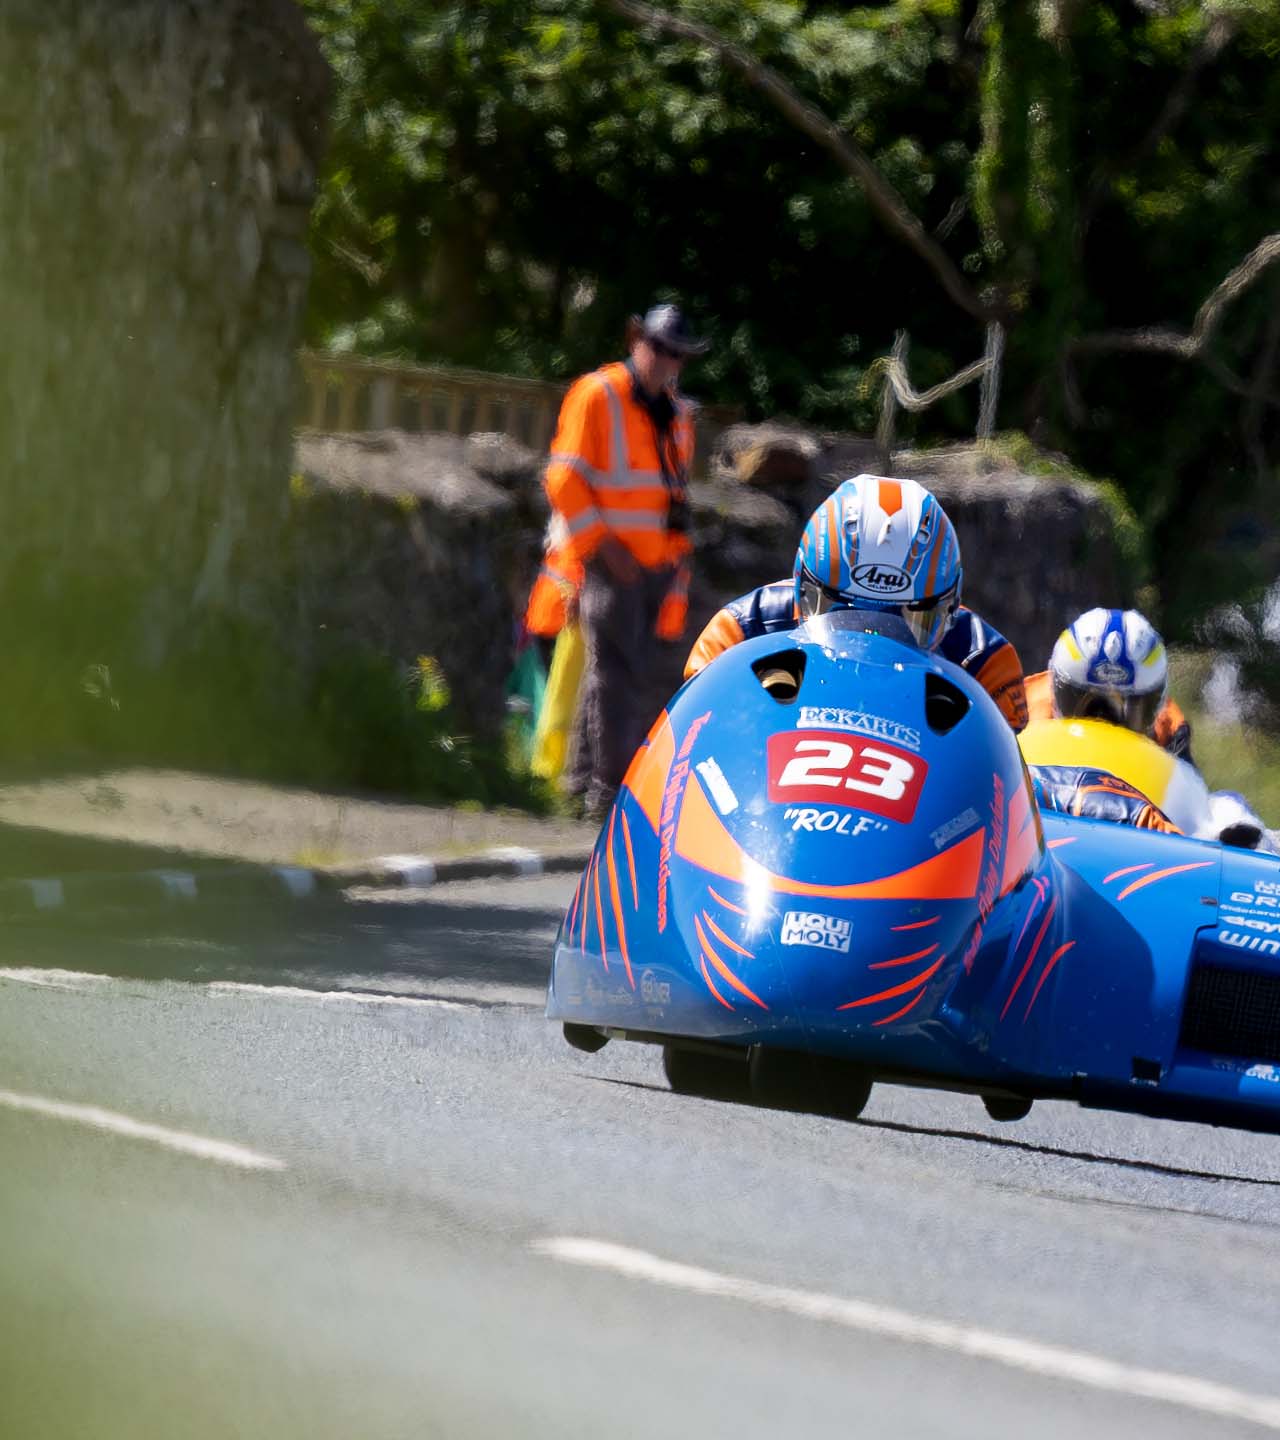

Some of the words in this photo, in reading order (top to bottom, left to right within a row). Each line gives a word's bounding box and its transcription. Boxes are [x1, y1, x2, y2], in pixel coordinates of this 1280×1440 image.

[856, 567, 904, 587] Arai
[799, 706, 920, 746] ECKARTS
[778, 740, 914, 800] 23
[784, 808, 888, 836] "ROLF"
[786, 913, 850, 936] LIQUI
[787, 929, 847, 948] MOLY
